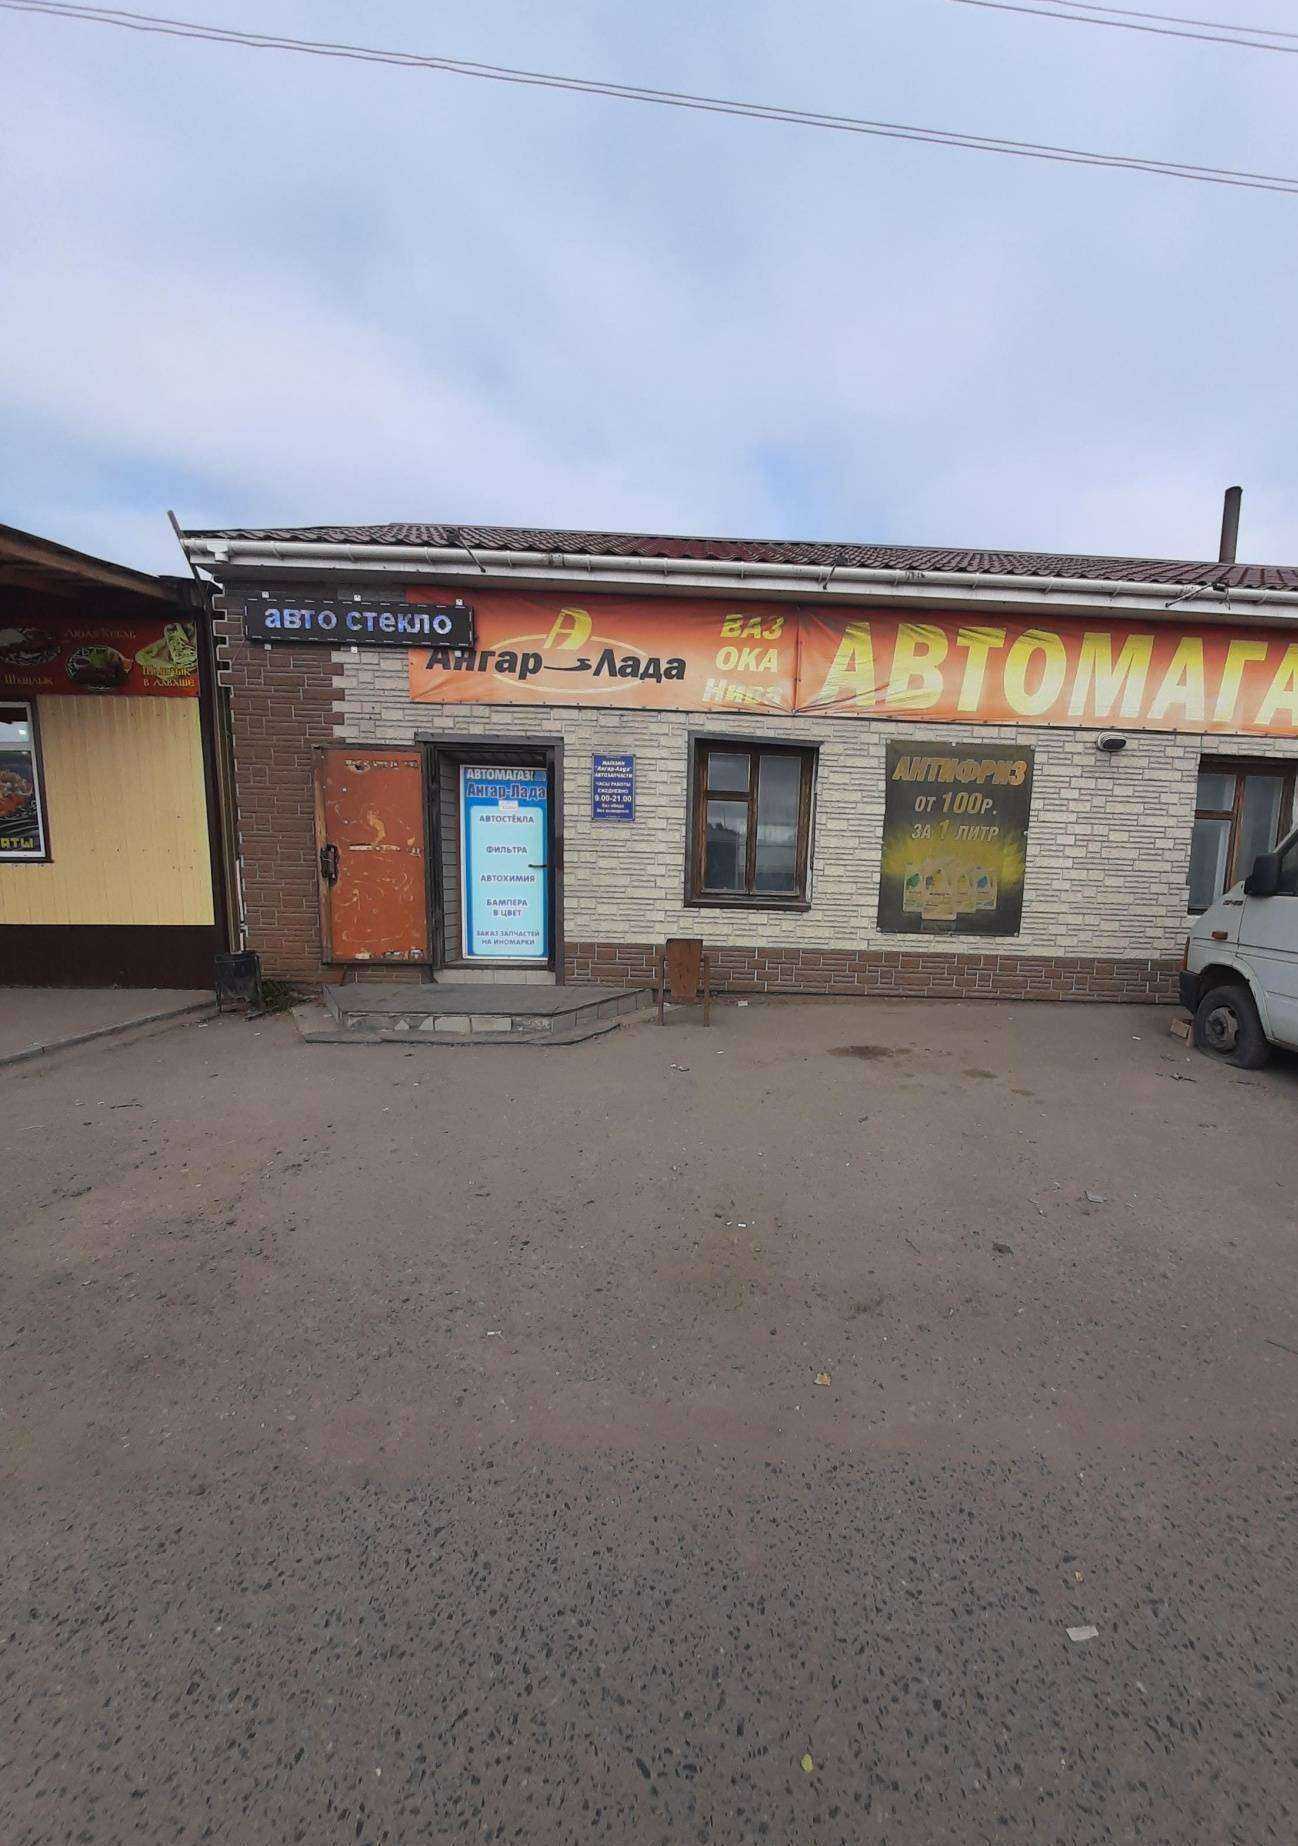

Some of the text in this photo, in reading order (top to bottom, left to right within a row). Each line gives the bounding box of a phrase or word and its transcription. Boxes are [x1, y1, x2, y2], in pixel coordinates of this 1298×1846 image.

[264, 608, 453, 636] авто стекло
[720, 613, 784, 640] ВАЗ
[425, 646, 687, 683] Ангар Лада
[715, 646, 778, 673] ОКА
[815, 622, 1298, 727] АВТОМАГА
[891, 756, 1028, 786] АНТИФРИЗ
[466, 782, 547, 801] Ангар-Лада
[956, 825, 999, 841] ЛИТР
[486, 845, 528, 855] ФИЛЬТРА
[480, 874, 536, 884] АВТОХИМИЯ
[486, 898, 528, 907] БАМПЕРА
[500, 909, 522, 917] ЦВЕТ
[499, 929, 540, 937] ЗАПЧАСТЕЙ
